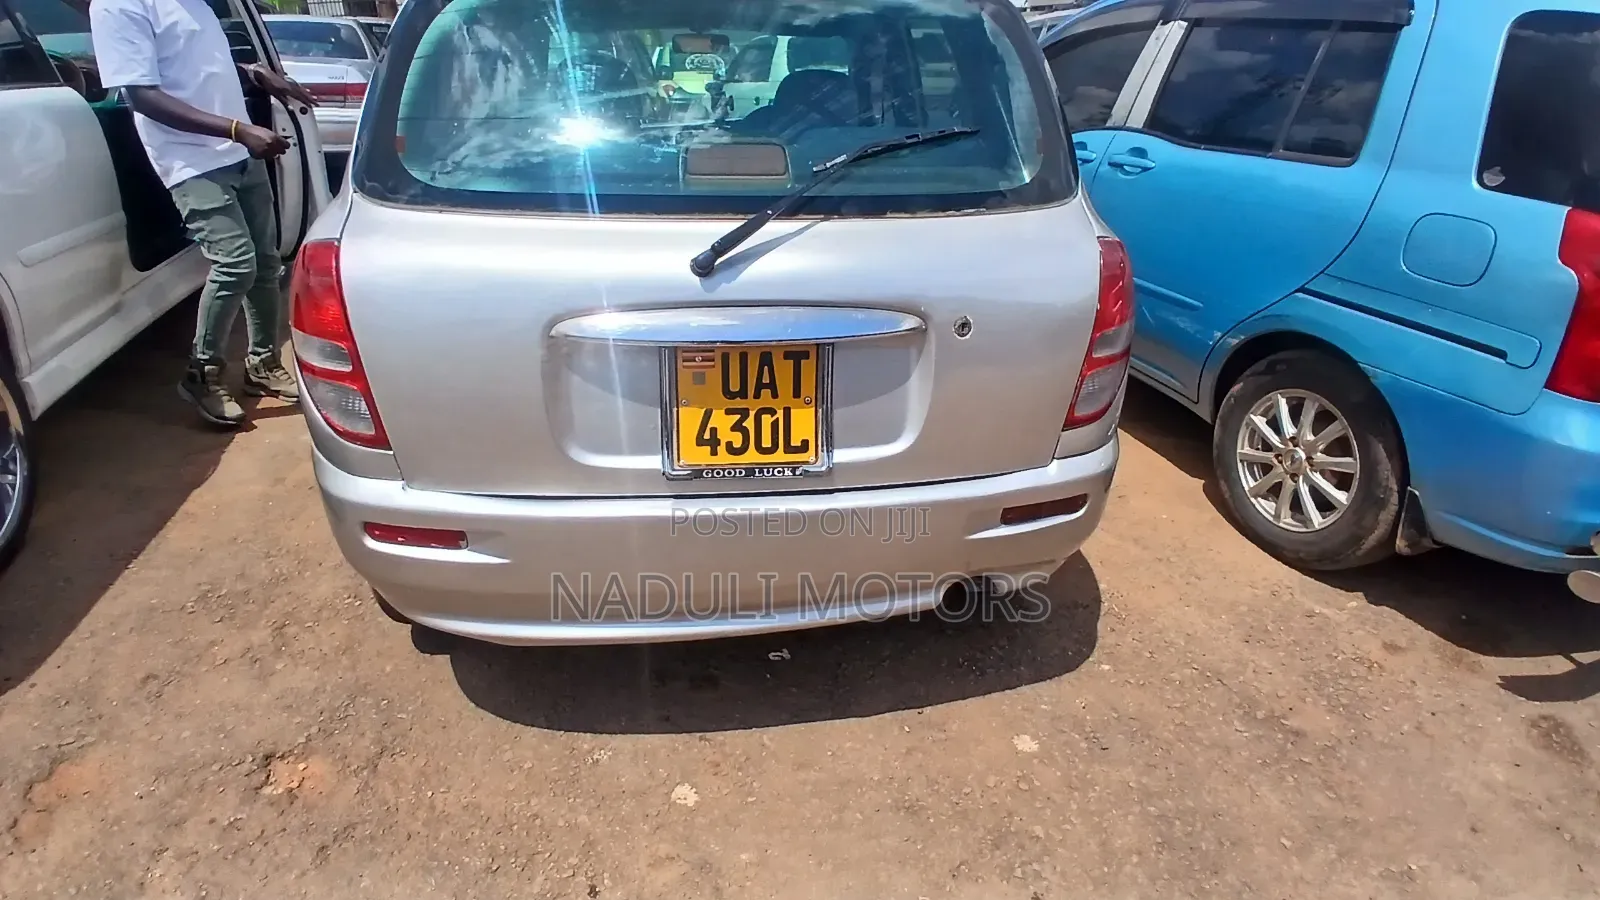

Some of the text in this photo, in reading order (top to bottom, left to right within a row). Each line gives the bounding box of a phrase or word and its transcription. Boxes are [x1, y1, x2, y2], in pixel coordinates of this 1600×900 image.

[721, 351, 810, 400] UAT
[695, 407, 810, 456] 430L
[702, 467, 793, 478] GOOD LUCK
